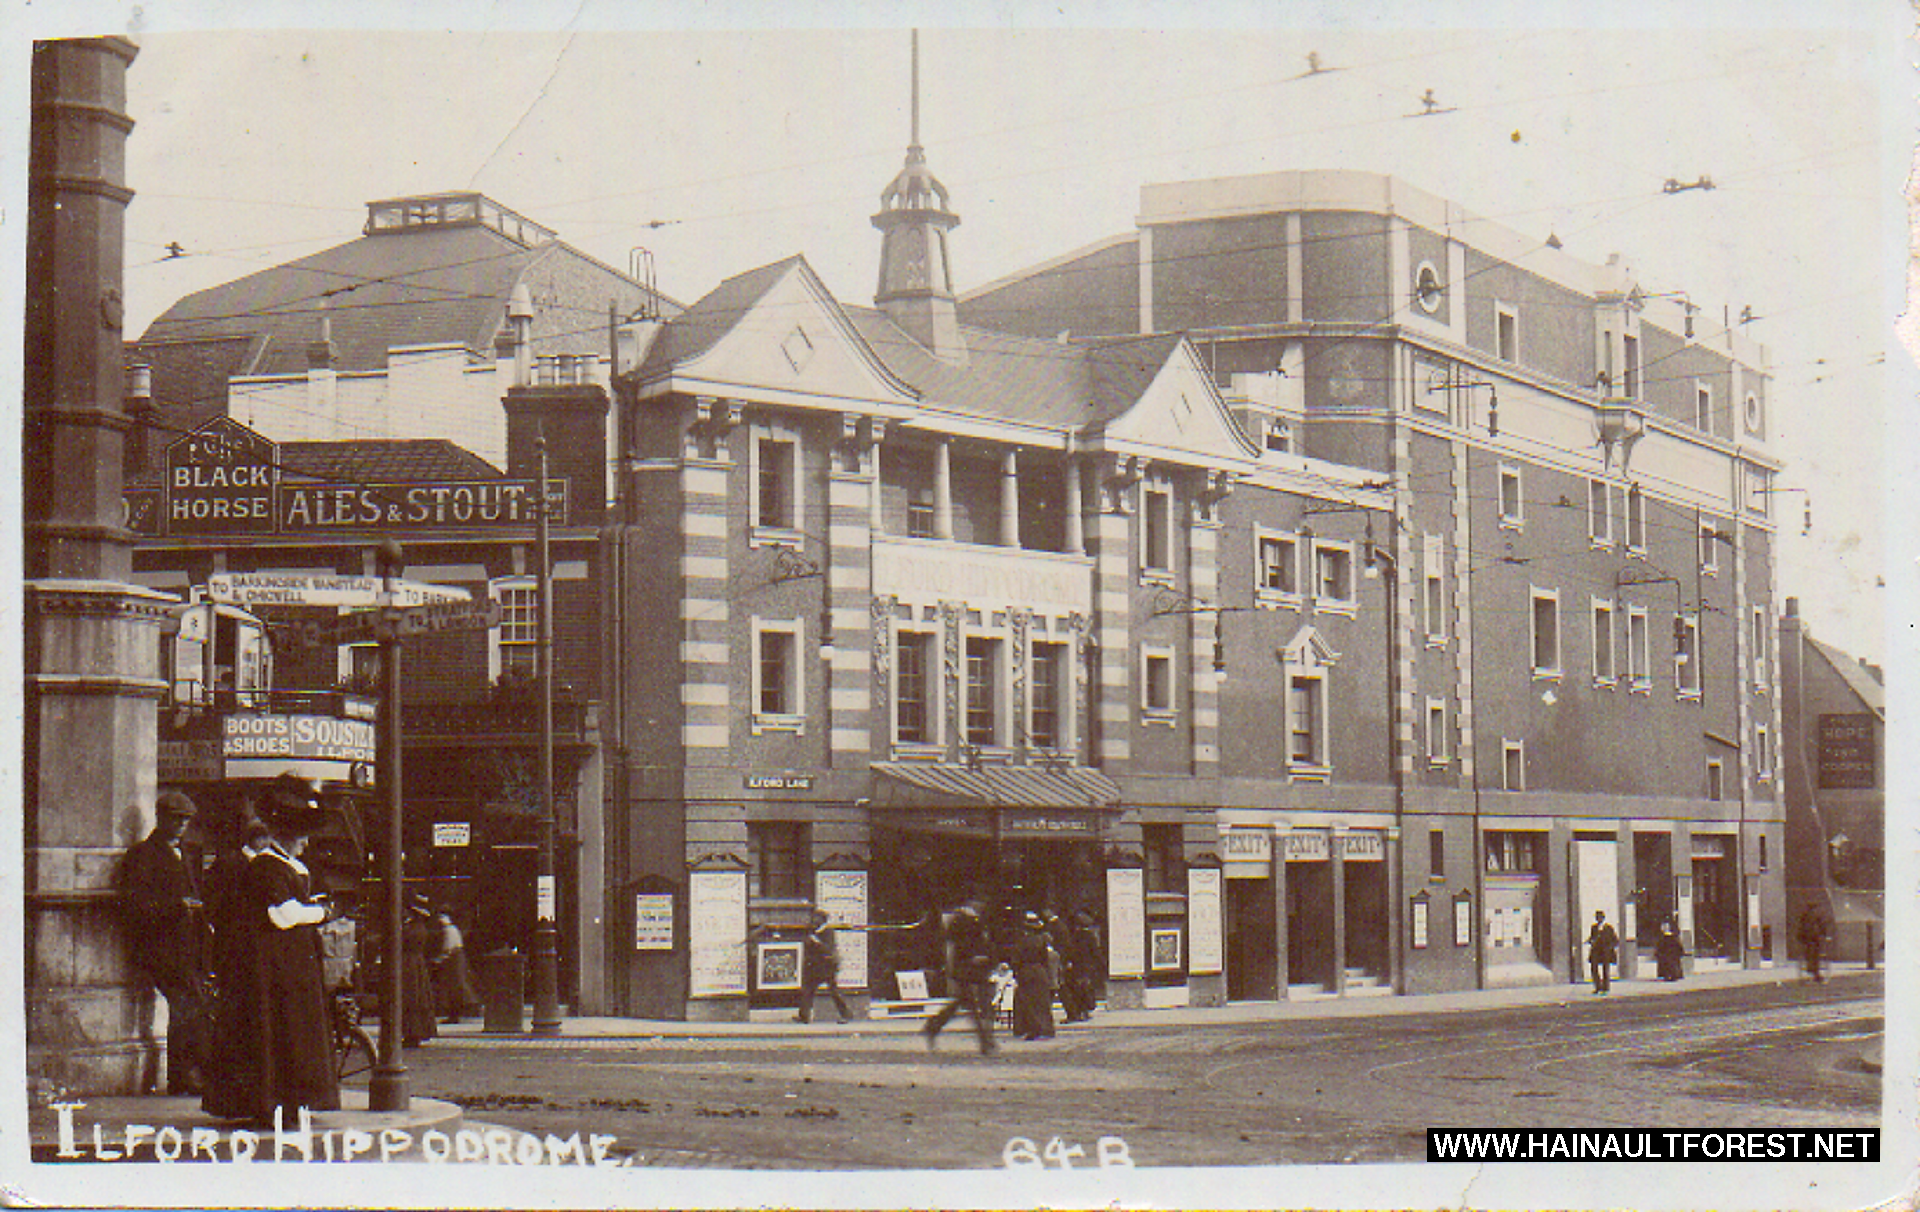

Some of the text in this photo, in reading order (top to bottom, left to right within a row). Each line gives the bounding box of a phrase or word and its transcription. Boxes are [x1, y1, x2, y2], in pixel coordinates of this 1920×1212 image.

[174, 466, 269, 487] BLACK
[173, 497, 269, 519] HORSE
[287, 490, 382, 525] ALES
[387, 503, 403, 522] &
[407, 484, 525, 522] STOUT
[211, 580, 229, 595] TO
[405, 588, 418, 604] TO
[226, 717, 288, 734] BOOTS
[1228, 833, 1264, 853] EXIT
[1288, 833, 1323, 853] EXIT
[1346, 834, 1380, 854] EXIT
